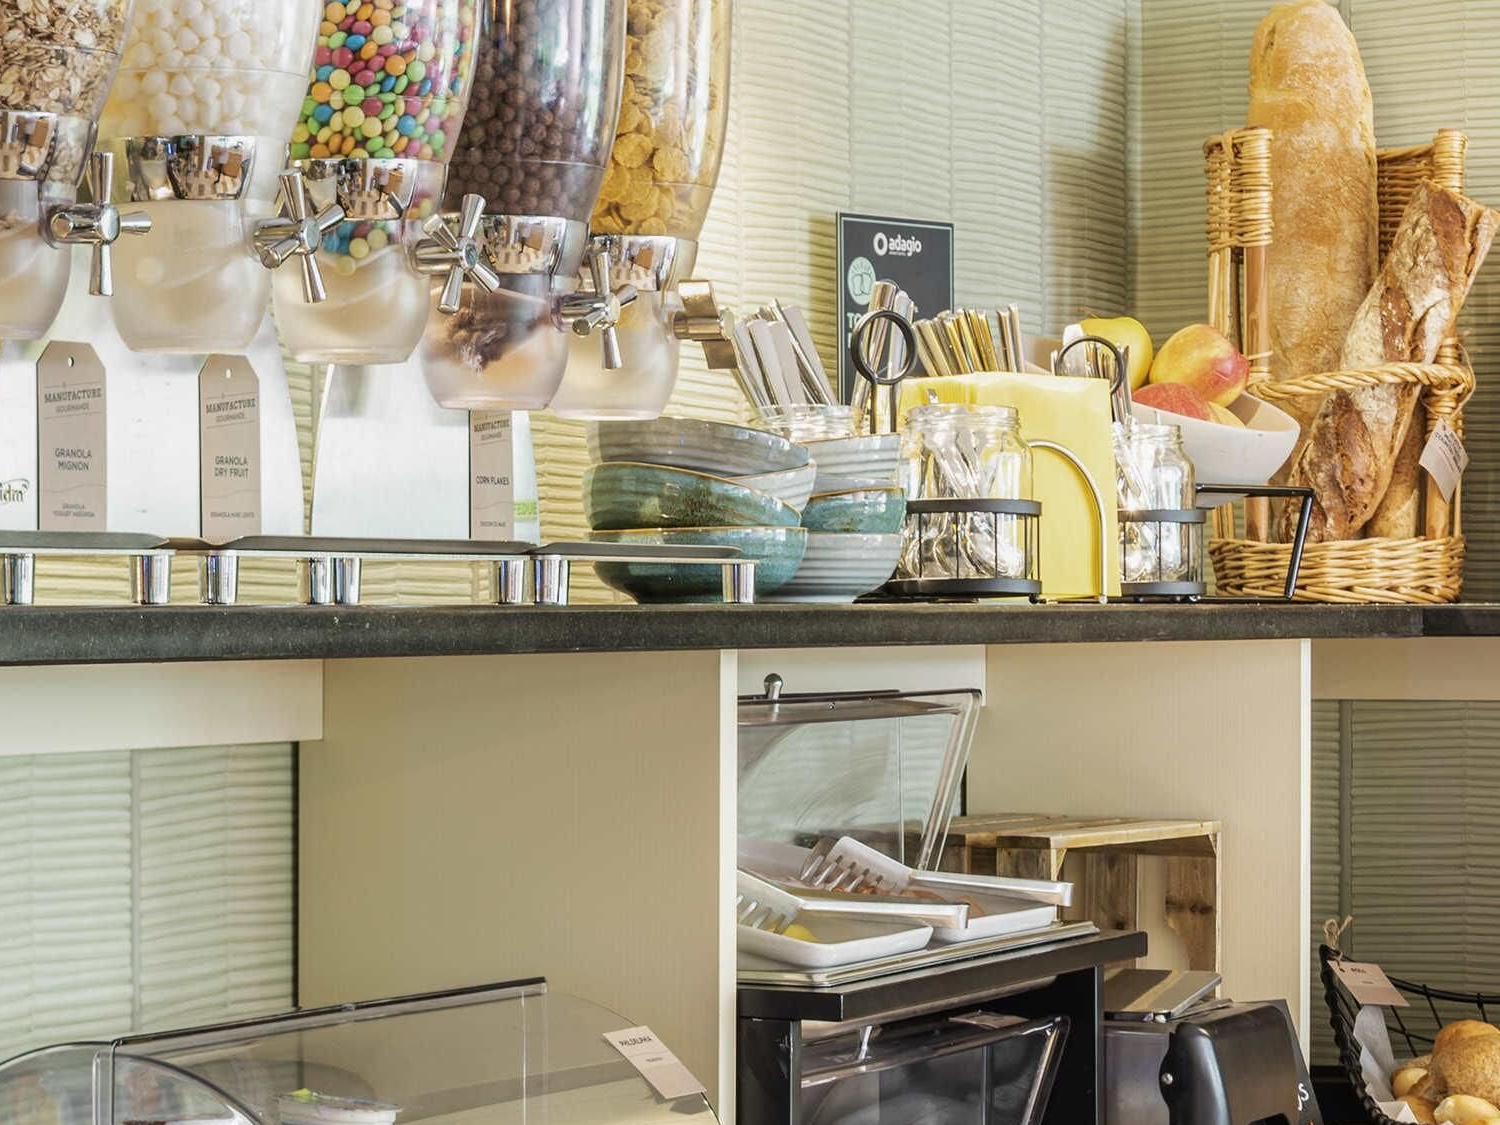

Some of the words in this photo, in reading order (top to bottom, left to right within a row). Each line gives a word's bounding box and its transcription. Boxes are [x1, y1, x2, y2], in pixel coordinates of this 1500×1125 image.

[888, 235, 922, 257] adagio
[44, 388, 102, 404] MANUFACTURE
[206, 398, 256, 414] MANUFACTURE
[54, 447, 92, 459] GRANOLA
[214, 456, 248, 466] GRANOLA
[229, 468, 249, 479] FRUIT
[476, 475, 490, 485] CORN
[490, 476, 510, 486] FLAKES
